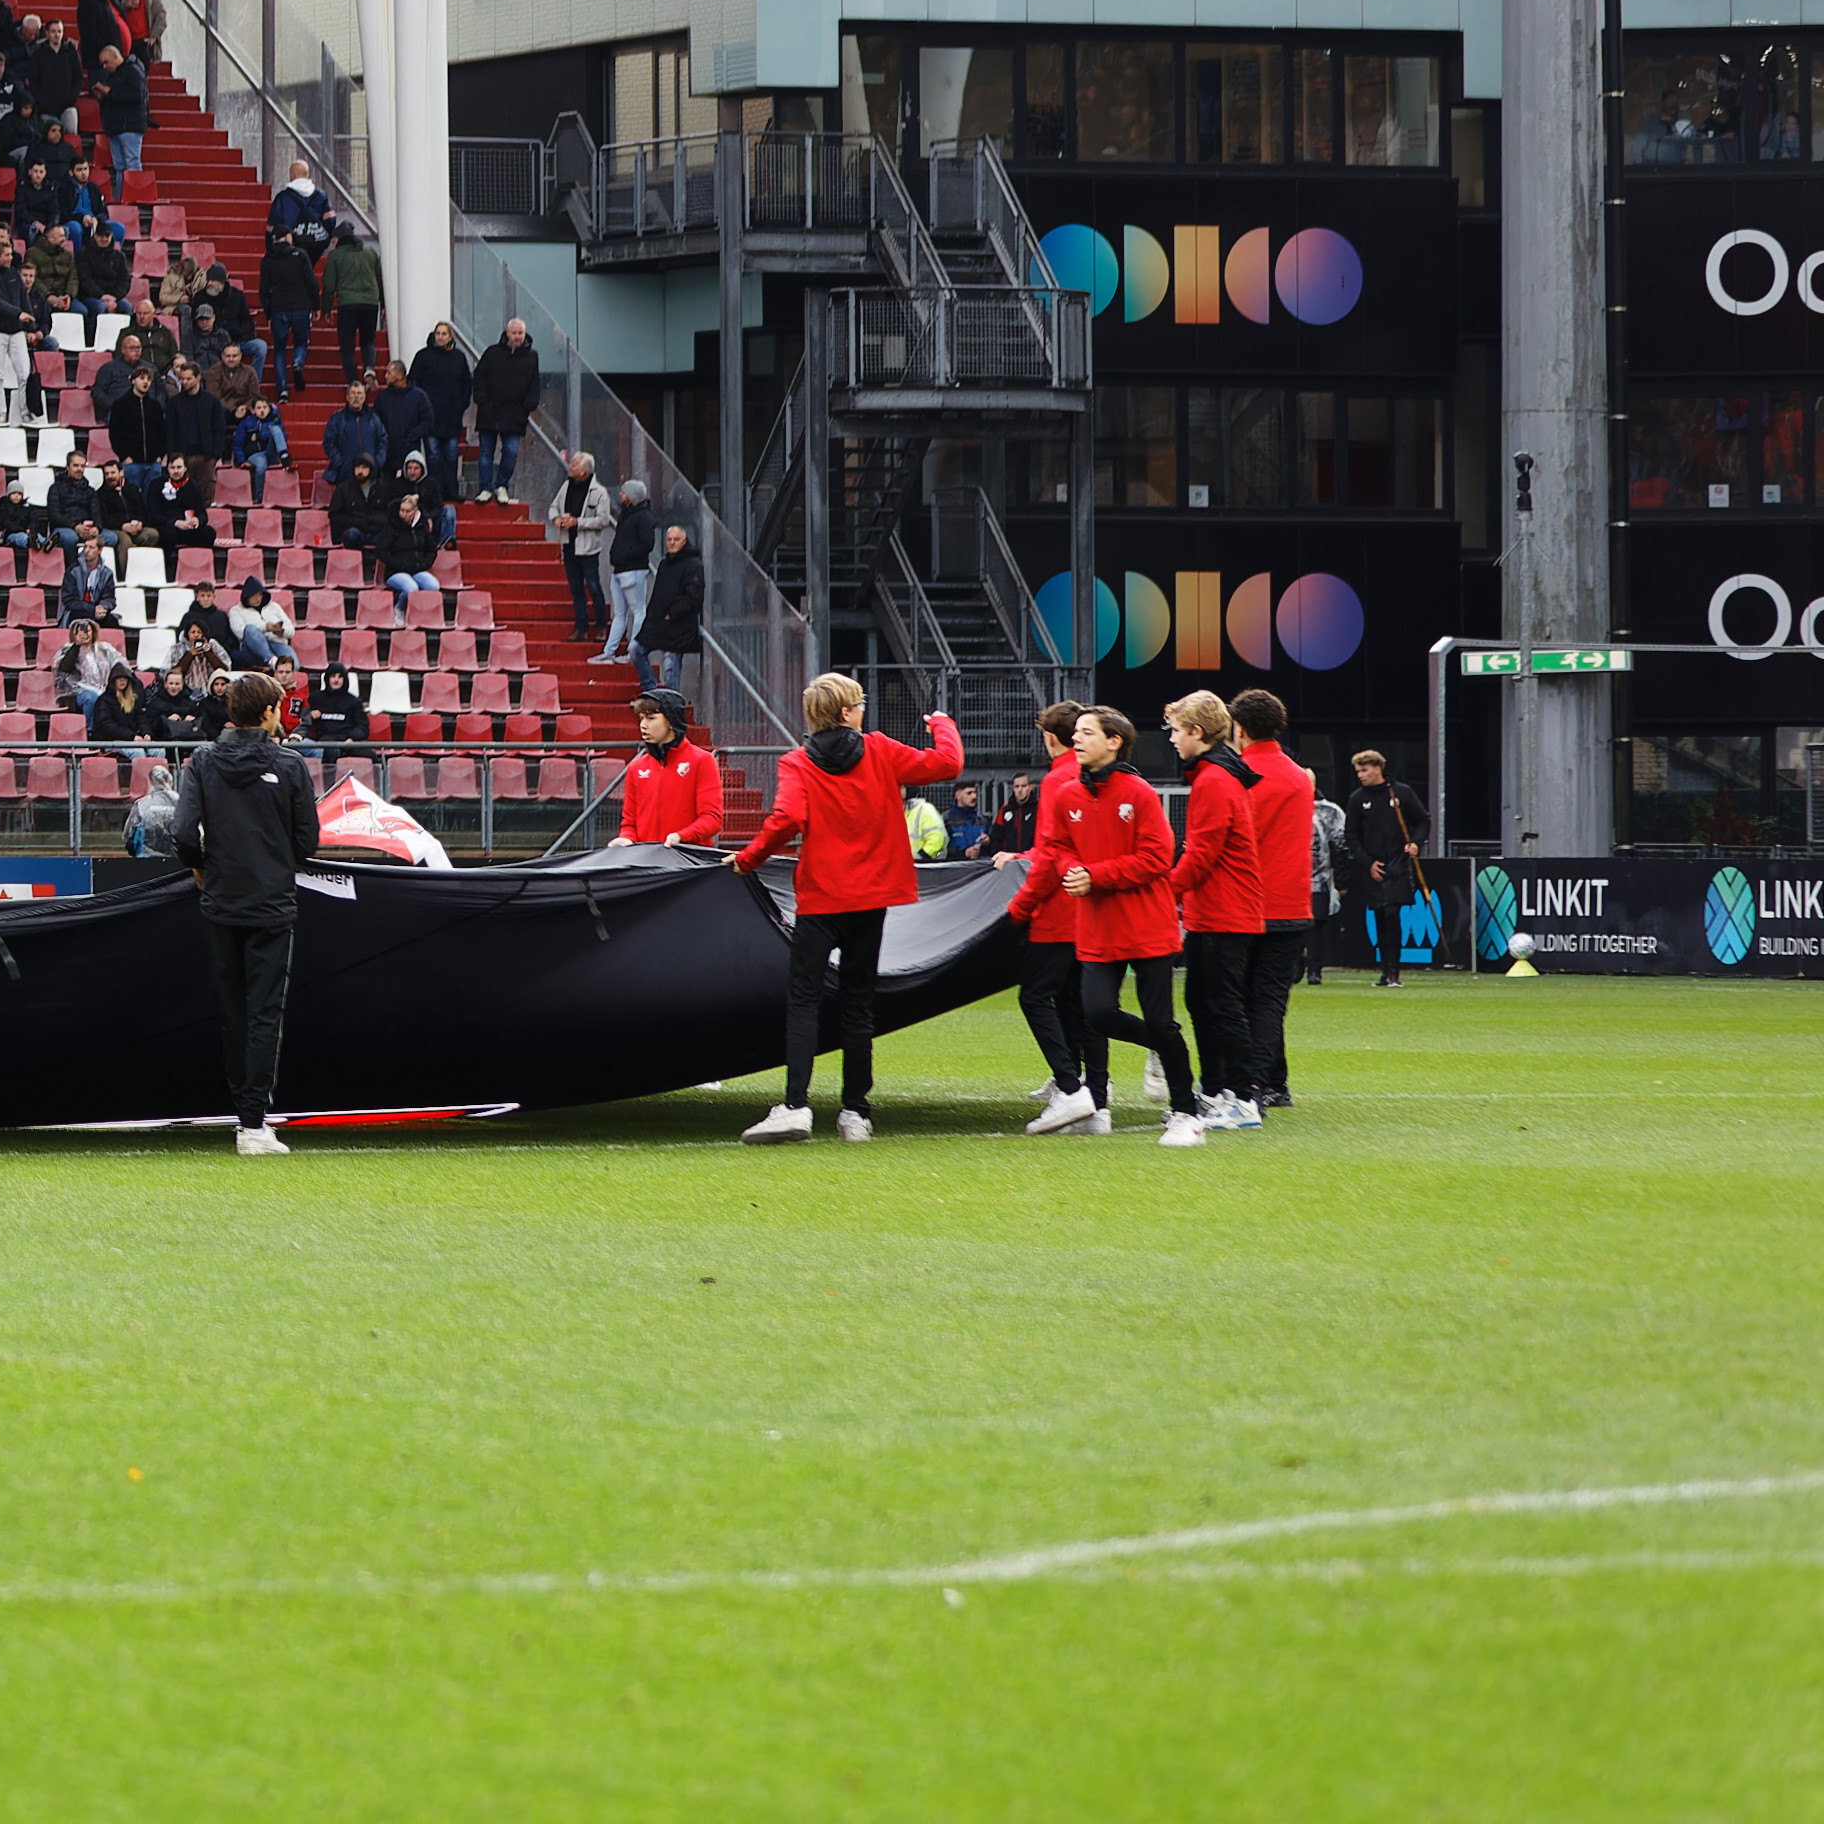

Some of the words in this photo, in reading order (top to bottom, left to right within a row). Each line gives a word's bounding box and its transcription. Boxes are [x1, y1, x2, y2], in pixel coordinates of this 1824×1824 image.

[1521, 878, 1609, 917] LINKIT
[1580, 934, 1592, 953] IT
[1593, 935, 1658, 955] TOGETHER
[1759, 936, 1819, 956] BUILDING
